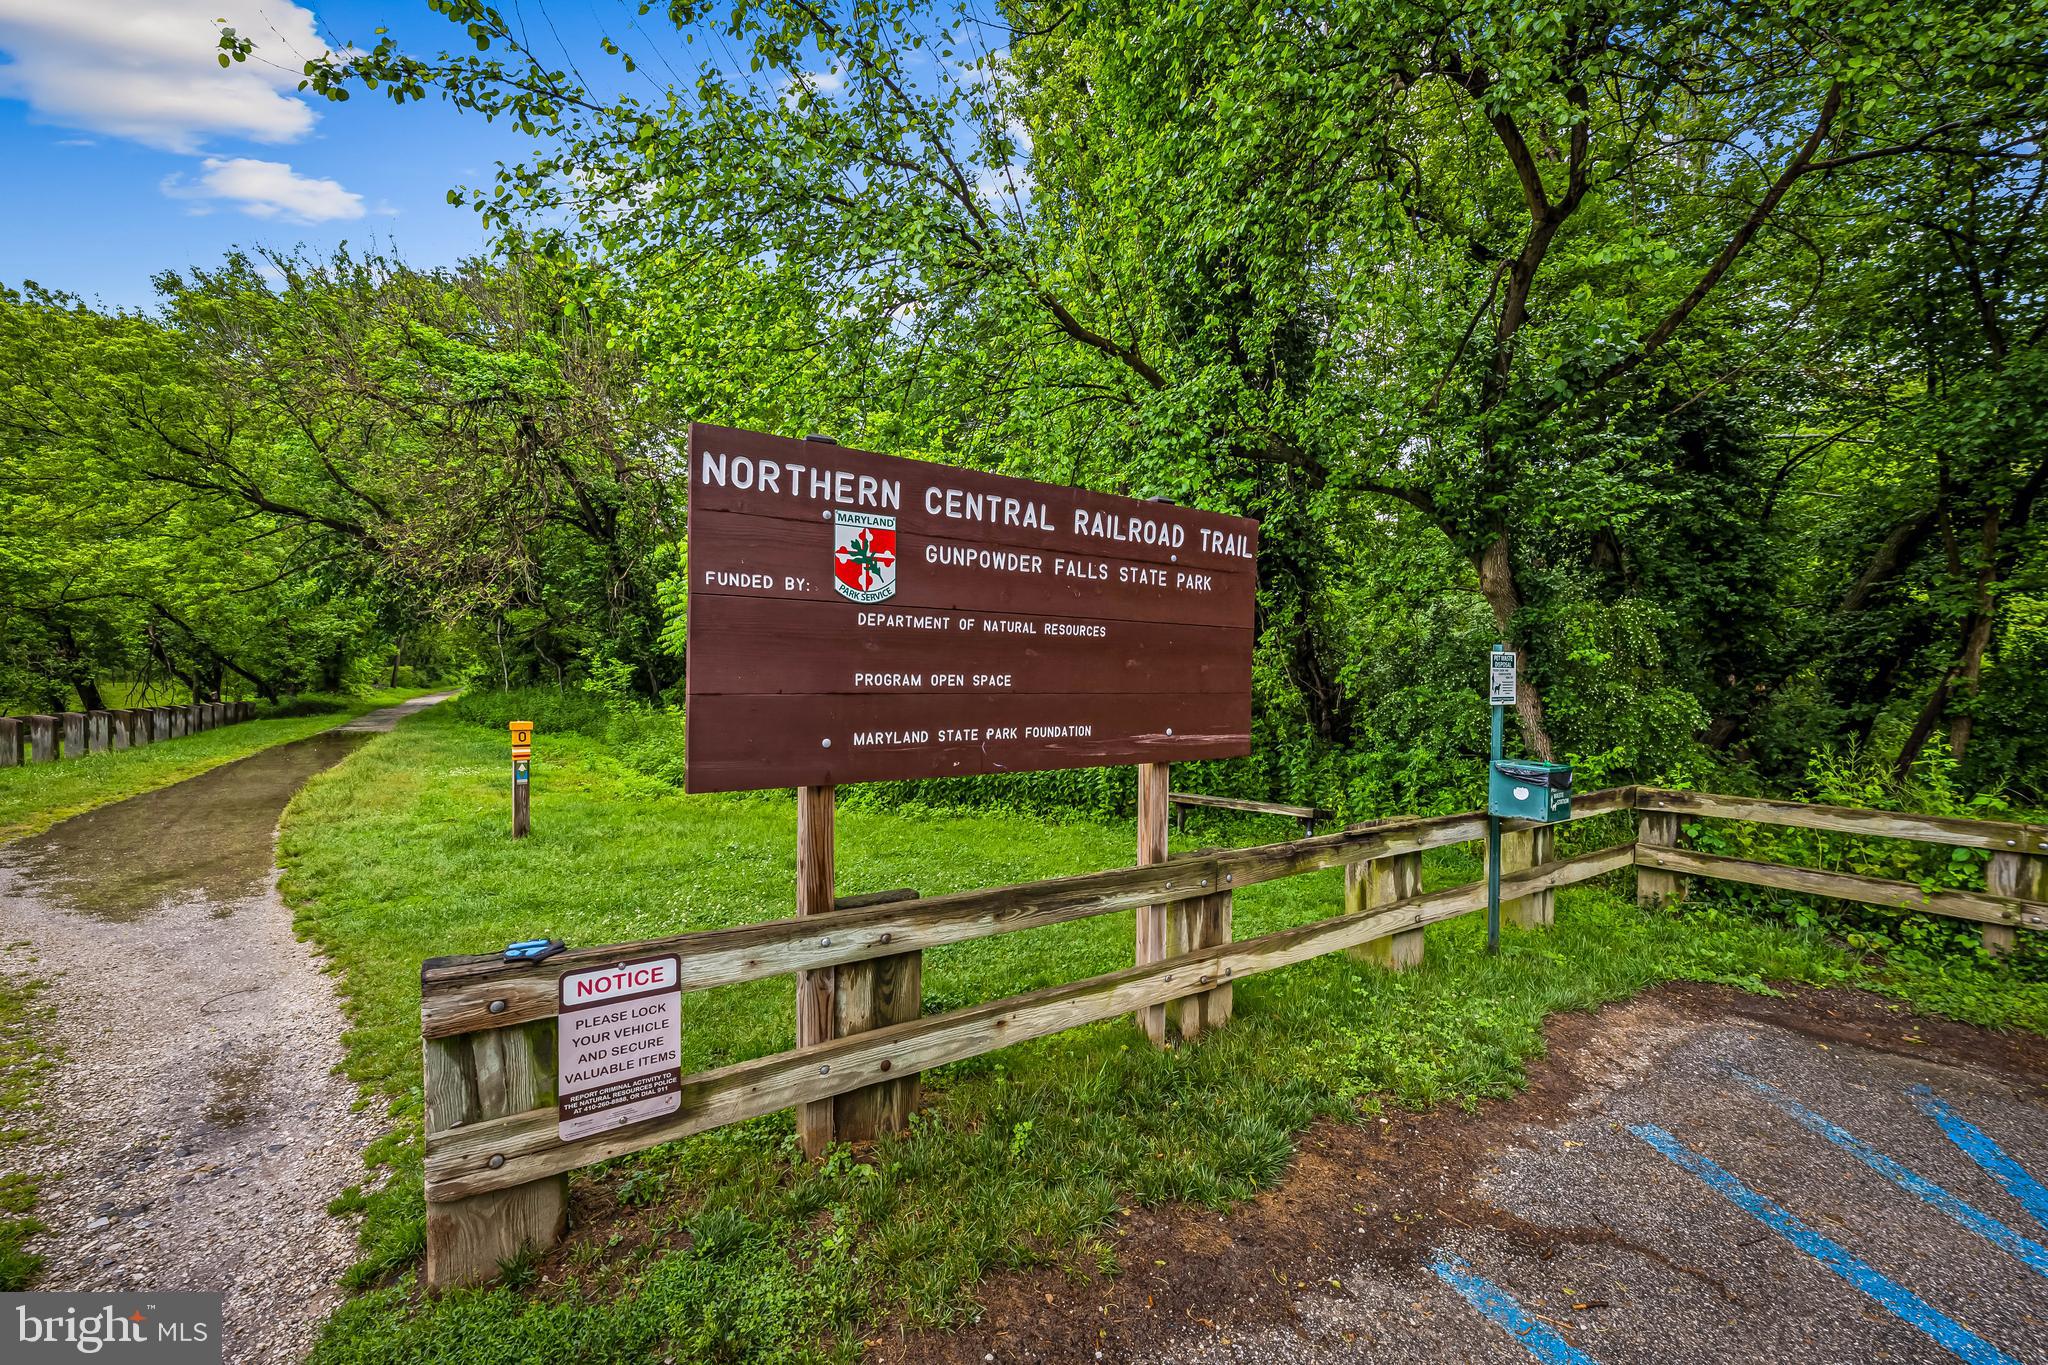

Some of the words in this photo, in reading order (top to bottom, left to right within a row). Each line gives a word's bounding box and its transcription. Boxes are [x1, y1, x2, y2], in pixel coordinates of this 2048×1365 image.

[702, 451, 900, 510] NORTHERN
[925, 486, 1055, 531] CENTRAL
[1074, 509, 1185, 548] RAILROAD
[1200, 528, 1253, 559] TRAIL
[837, 513, 894, 527] MARYLAND
[925, 544, 1042, 574] GUNPOWDER
[1054, 558, 1108, 581] FALLS
[1119, 566, 1167, 587] STATE
[1177, 573, 1212, 591] PARK
[705, 571, 773, 589] FUNDED
[785, 577, 810, 592] BY:
[838, 584, 859, 600] PARK
[860, 586, 892, 601] SERVICE
[858, 612, 950, 630] DEPARTMENT
[959, 618, 975, 631] OF
[983, 620, 1037, 634] NATURAL
[1044, 623, 1106, 637] RESOURCES
[855, 673, 921, 687] PROGRAM
[930, 674, 964, 687] OPEN
[972, 674, 1012, 687] SPACE
[519, 732, 527, 742] 0
[853, 731, 928, 746] MARYLAND
[938, 728, 979, 742] STATE
[986, 727, 1018, 740] PARK
[1025, 725, 1092, 738] FOUNDATION
[577, 966, 664, 998] NOTICE
[575, 1010, 628, 1030] PLEASE
[631, 1003, 667, 1019] LOCK
[572, 1031, 610, 1048] YOUR
[613, 1018, 670, 1039] VEHICLE
[577, 1049, 607, 1064] AND
[611, 1036, 664, 1056] SECURE
[564, 1059, 635, 1084] VALUABLE
[638, 1050, 676, 1067] ITEMS
[563, 1103, 578, 1111] THE
[579, 1095, 611, 1107] NATURAL
[612, 1084, 653, 1098] RESOURCES
[653, 1077, 677, 1087] POLICE
[570, 1090, 598, 1103] REPORT
[599, 1084, 631, 1095] CRIMINAL
[633, 1075, 661, 1086] ACTIVITY
[641, 1089, 656, 1097] DIAL
[657, 1085, 668, 1093] 911
